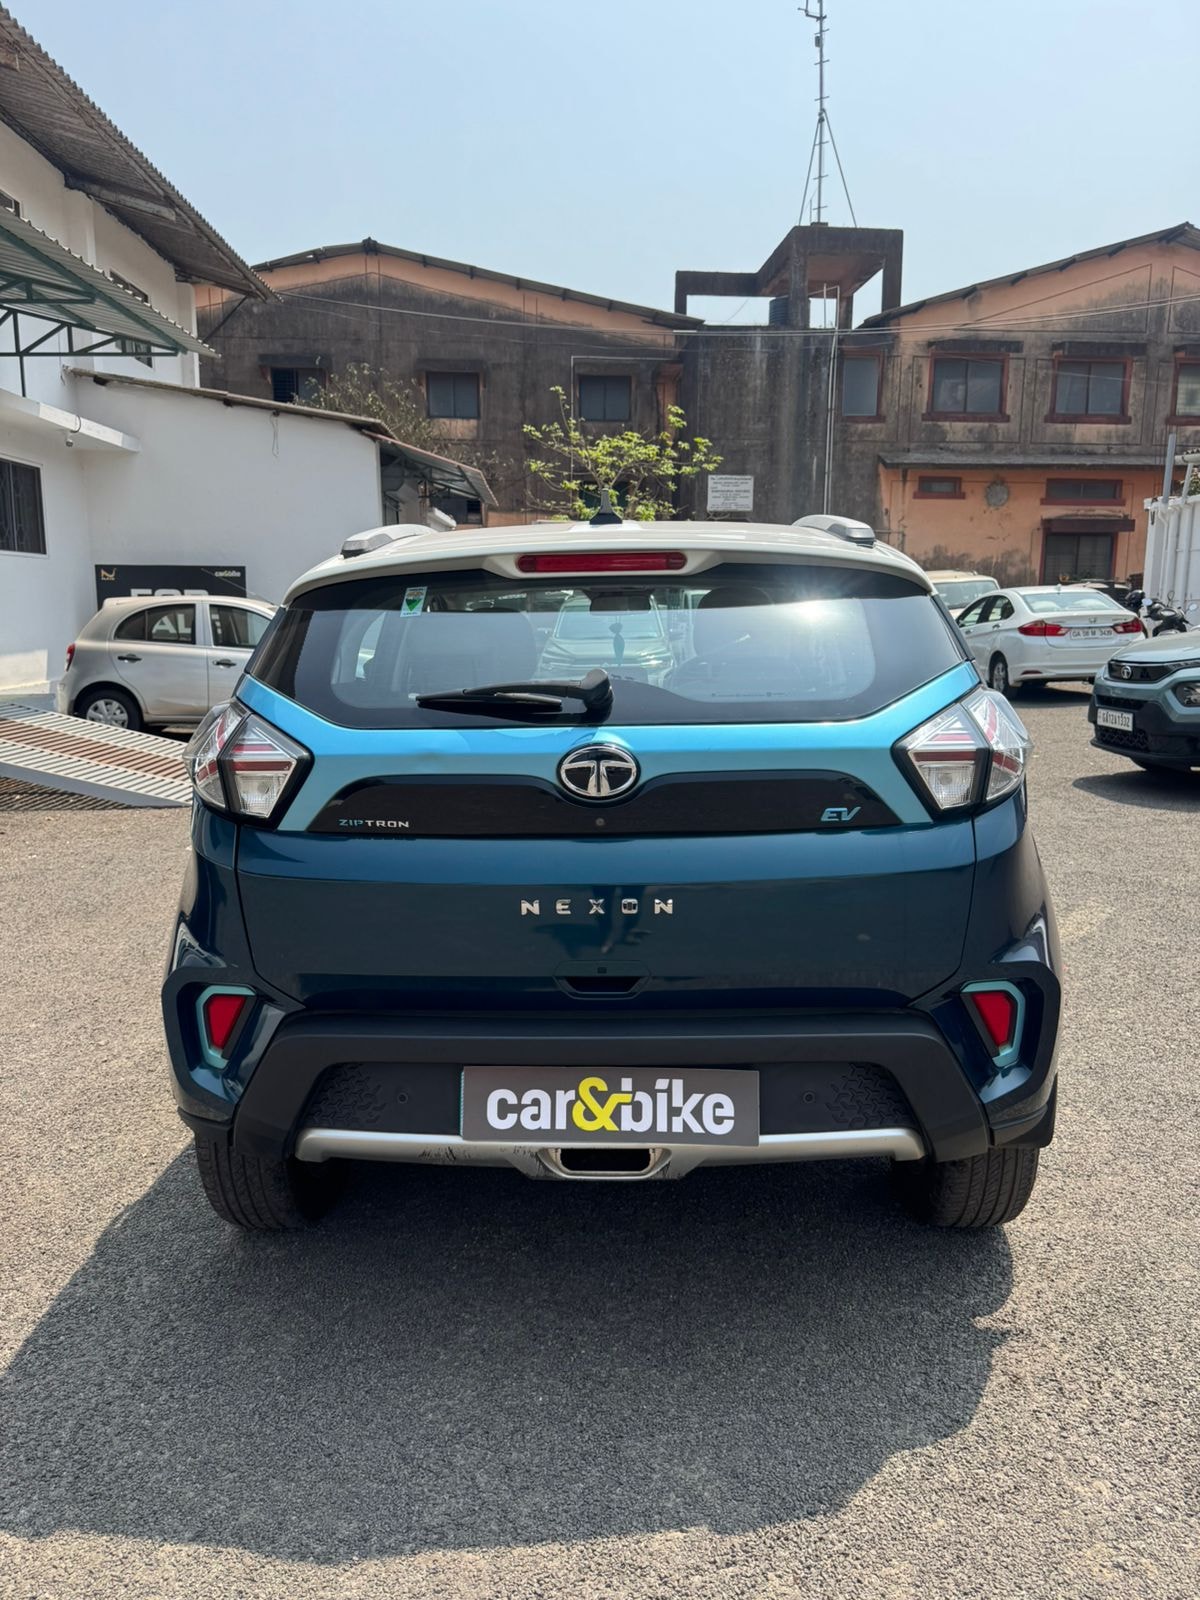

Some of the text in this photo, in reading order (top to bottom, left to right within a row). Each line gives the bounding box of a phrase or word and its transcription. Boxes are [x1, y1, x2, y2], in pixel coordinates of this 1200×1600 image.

[821, 806, 862, 821] EV
[339, 820, 409, 828] ZIPTRON
[520, 898, 674, 916] NEXON
[486, 1076, 735, 1136] car&bike
